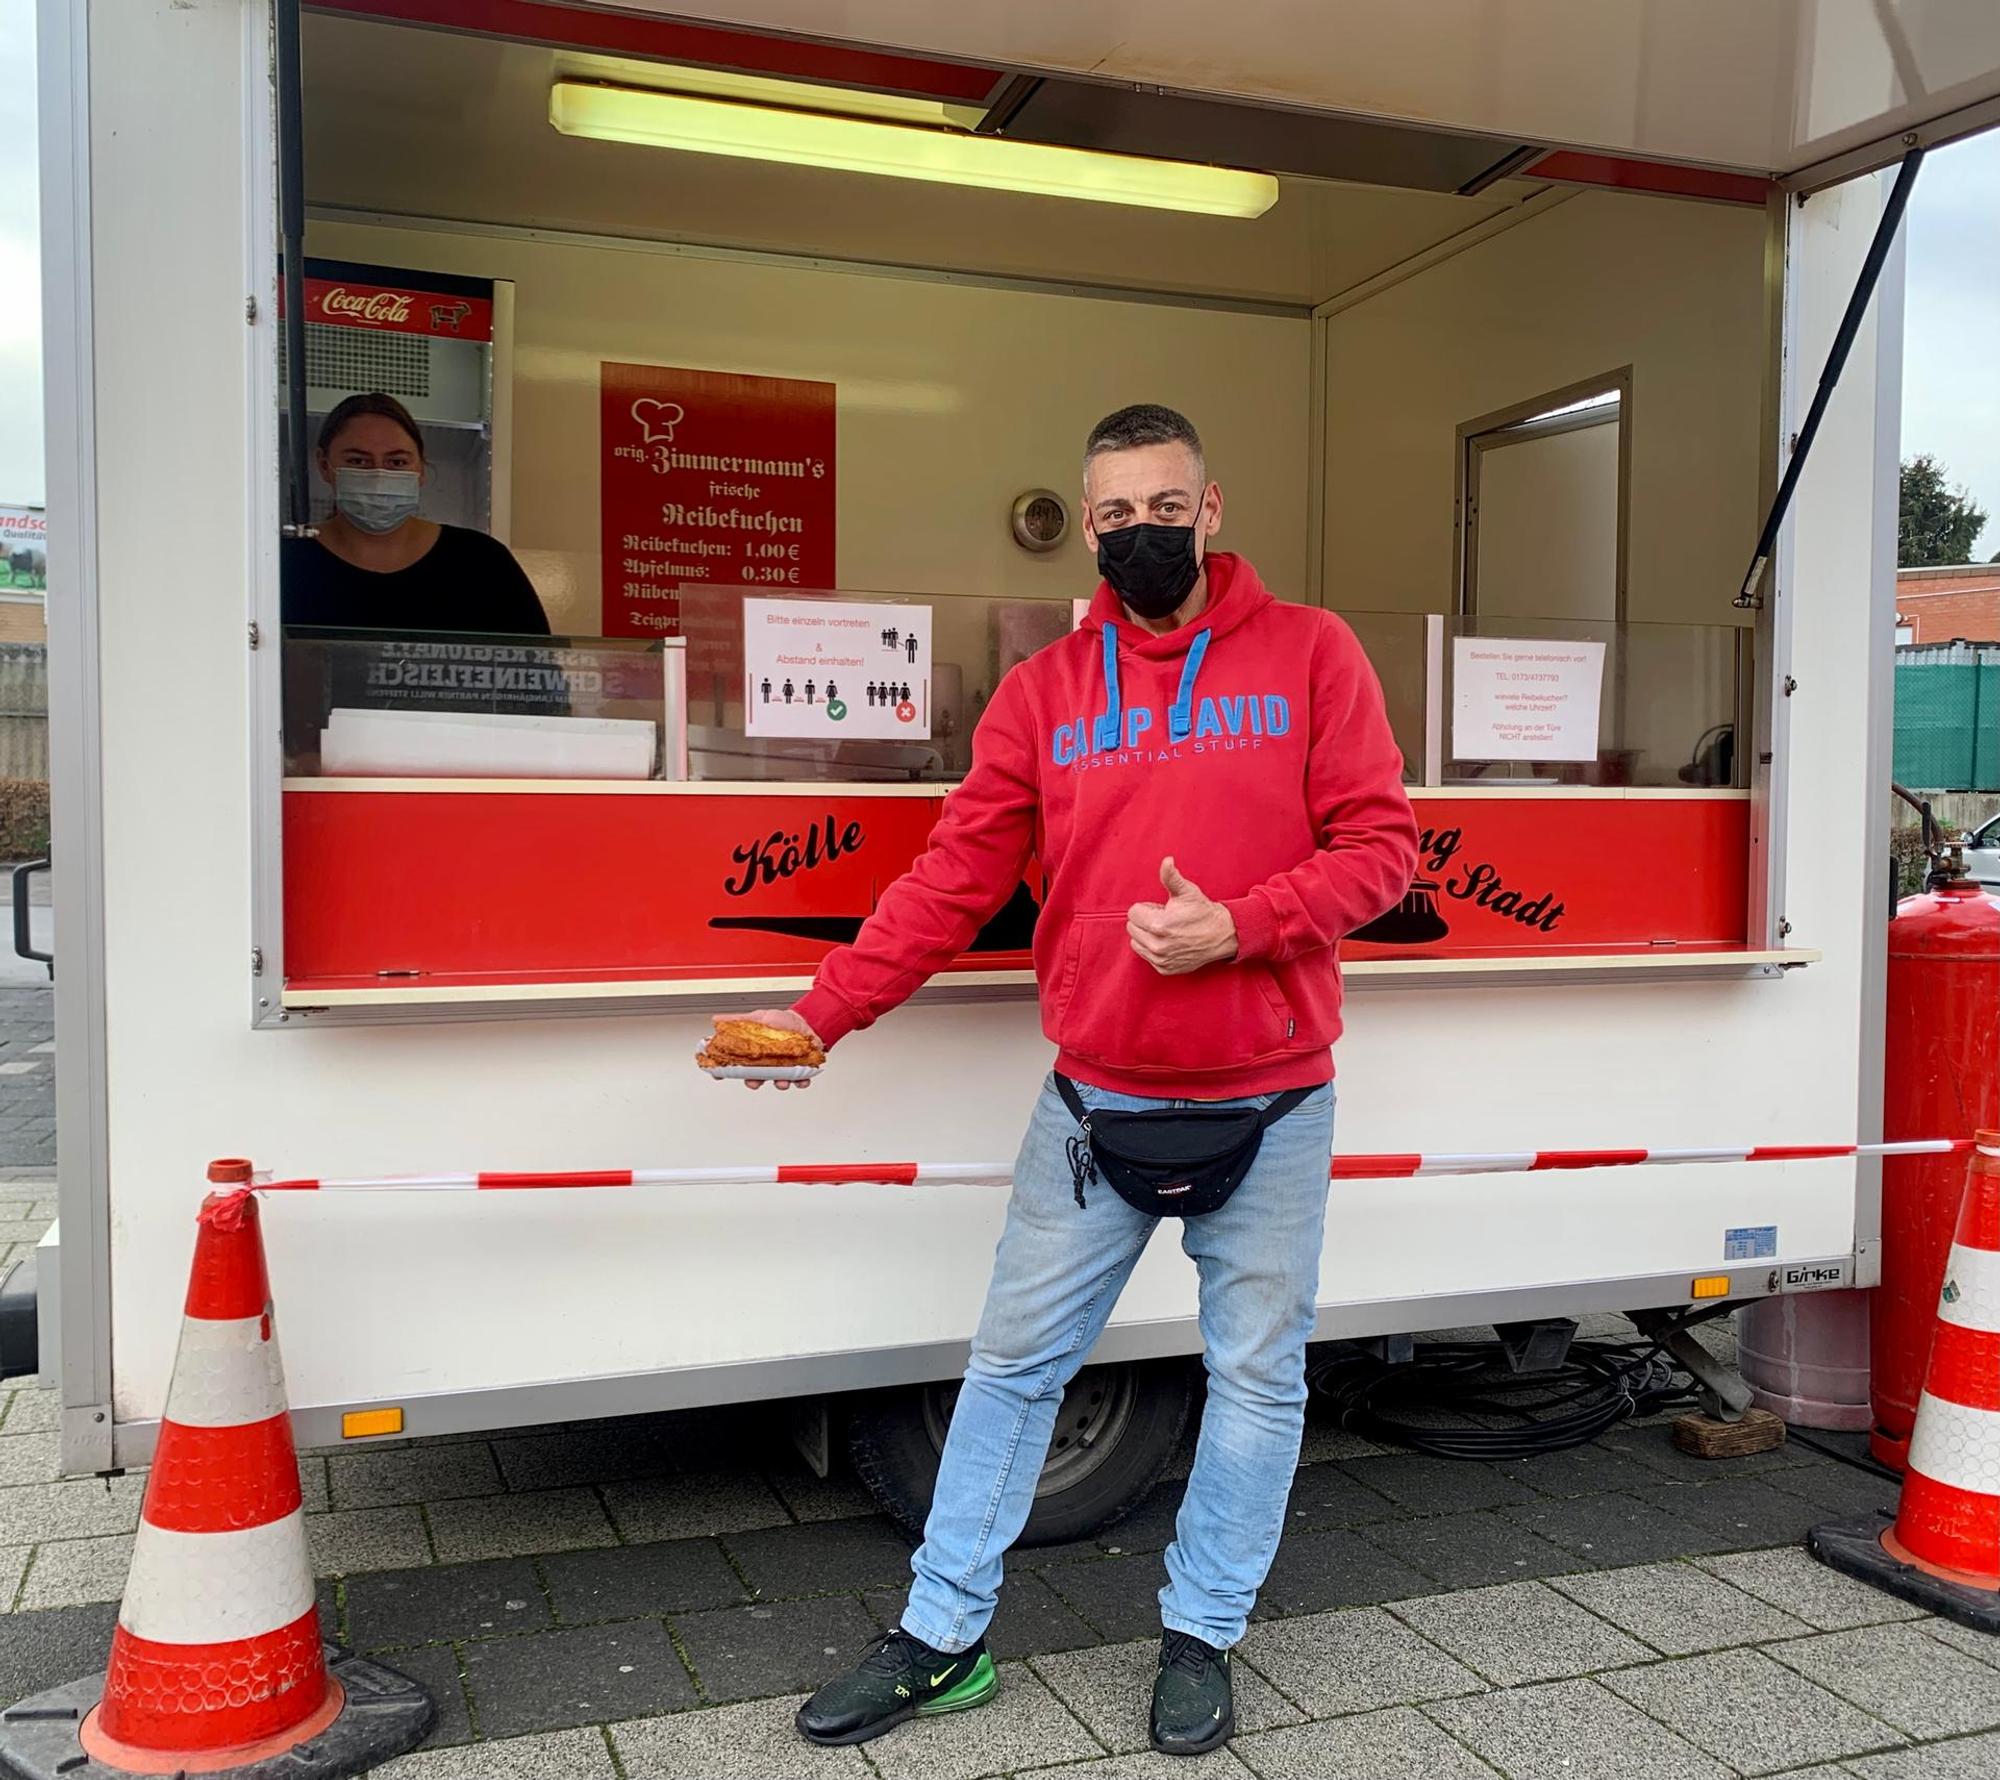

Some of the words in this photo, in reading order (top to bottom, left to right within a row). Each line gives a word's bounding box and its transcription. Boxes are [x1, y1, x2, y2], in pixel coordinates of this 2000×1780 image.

[322, 288, 415, 322] Coca-Cola
[614, 445, 649, 463] orig.
[651, 445, 825, 479] Zimmermann's
[709, 481, 761, 499] frische
[662, 503, 803, 536] Reibekuchen
[623, 534, 731, 558] Reibekuchen:
[623, 558, 710, 579] Apfelmus:
[623, 582, 680, 600] Rüben
[629, 611, 680, 630] Teigpr
[767, 614, 790, 625] Bitte
[791, 616, 826, 627] einzeln
[828, 619, 871, 628] vortreten
[776, 654, 817, 666] Abstand
[818, 657, 865, 668] einhalten!
[1053, 707, 1153, 766] CAP
[1072, 748, 1184, 774] ESSENTIAL
[1193, 738, 1263, 754] STUFF
[724, 814, 866, 896] Kölle
[1418, 827, 1462, 872] ng
[1446, 863, 1566, 932] Stadt
